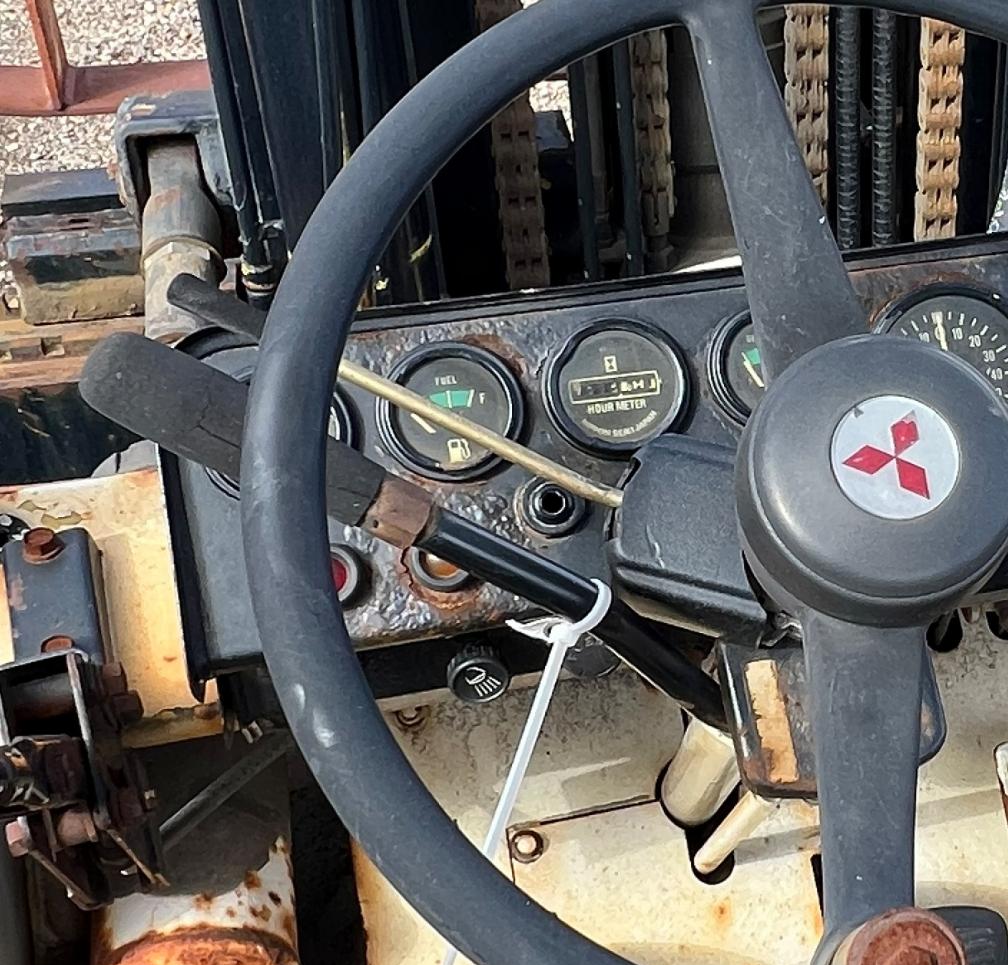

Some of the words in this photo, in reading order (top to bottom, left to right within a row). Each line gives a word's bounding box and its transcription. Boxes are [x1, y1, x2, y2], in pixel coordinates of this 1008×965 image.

[952, 327, 963, 340] 10
[969, 334, 981, 347] 20
[982, 350, 995, 362] 30
[435, 375, 457, 386] FUEL
[479, 392, 486, 404] F
[587, 401, 614, 414] HOUR
[616, 399, 647, 411] METER
